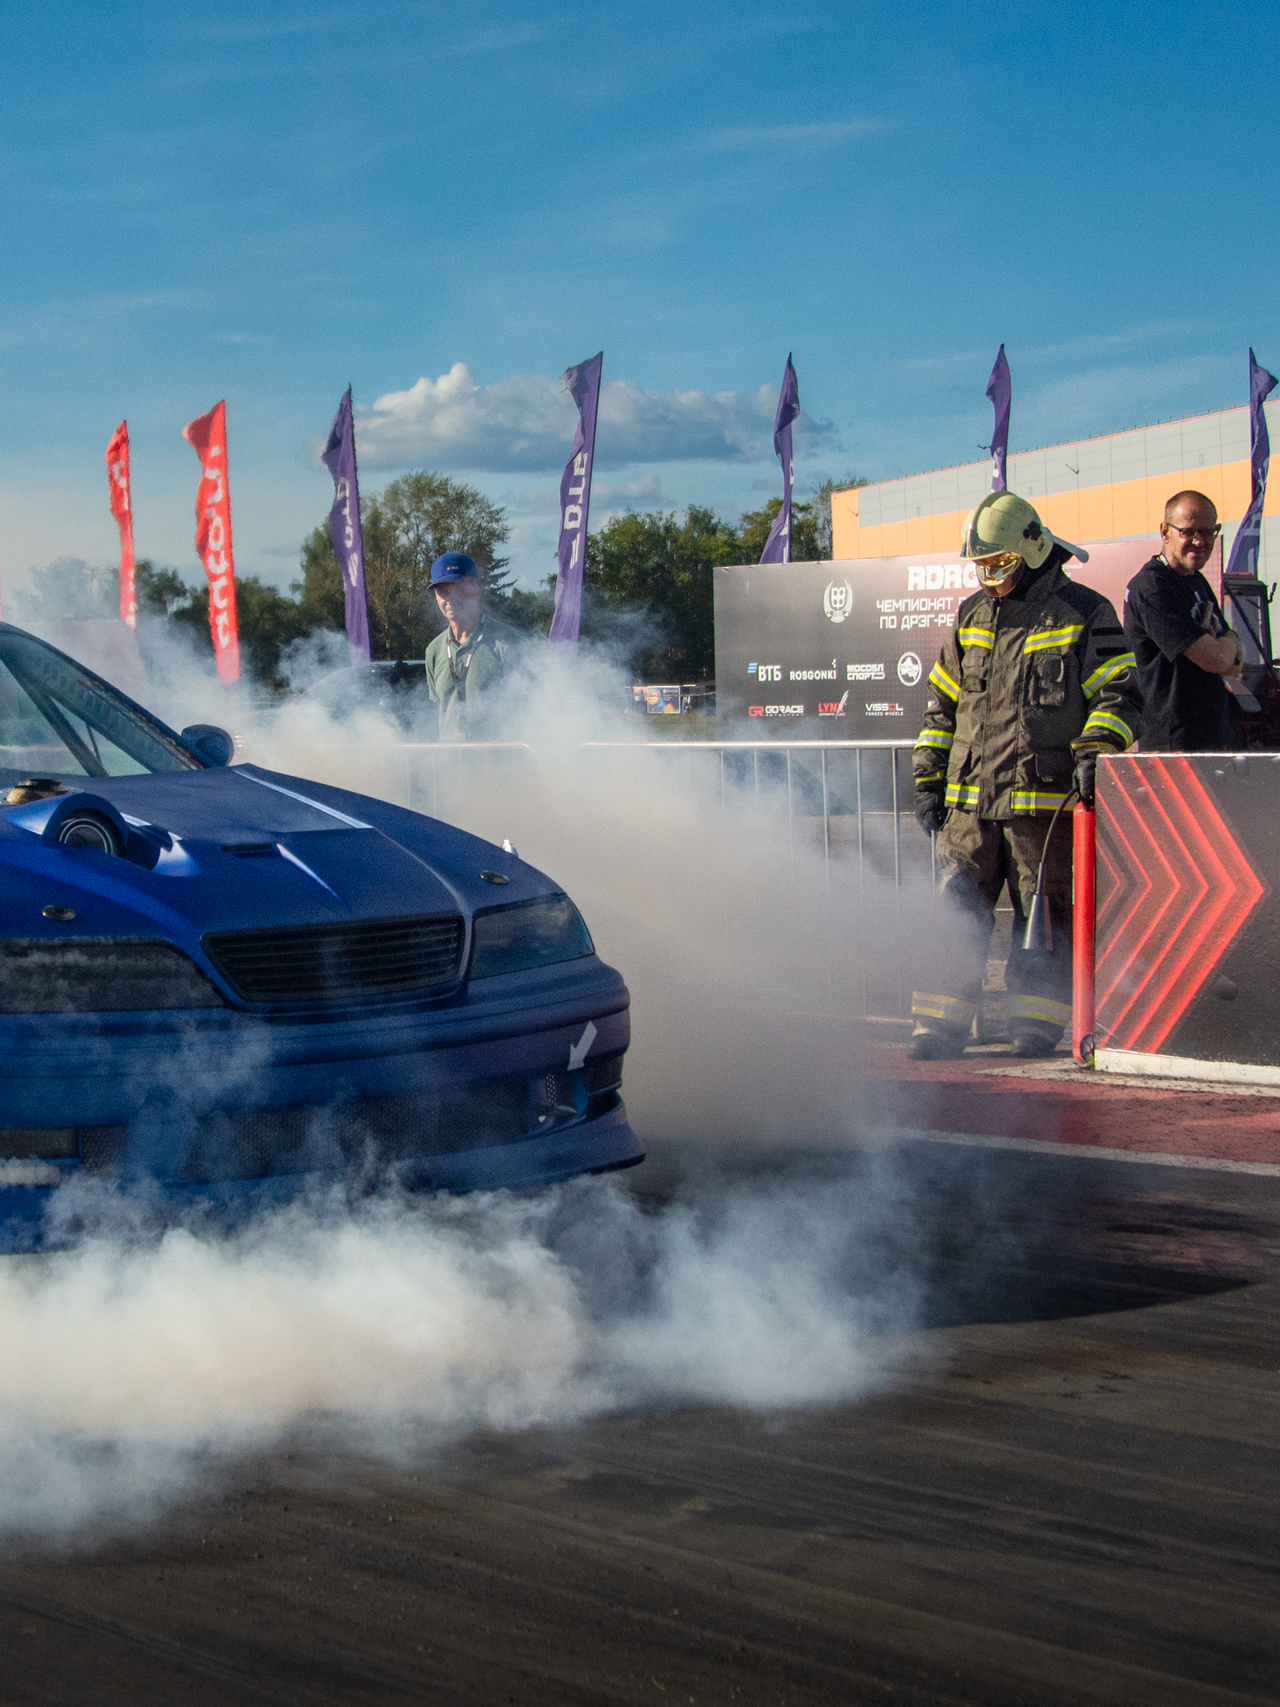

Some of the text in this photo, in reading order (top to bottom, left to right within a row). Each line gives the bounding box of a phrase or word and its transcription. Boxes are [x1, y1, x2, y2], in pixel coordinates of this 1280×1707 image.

[876, 597, 954, 613] ЧЕМПИОНАТ
[879, 614, 955, 631] ПО ДРЭГ-РЕ
[758, 665, 782, 682] ВТБ
[846, 663, 885, 673] МОСОБЛ
[789, 670, 837, 681] ROSGONKI
[846, 672, 879, 681] СПОРТ
[765, 705, 804, 714] GORACE
[818, 702, 844, 713] LYNX
